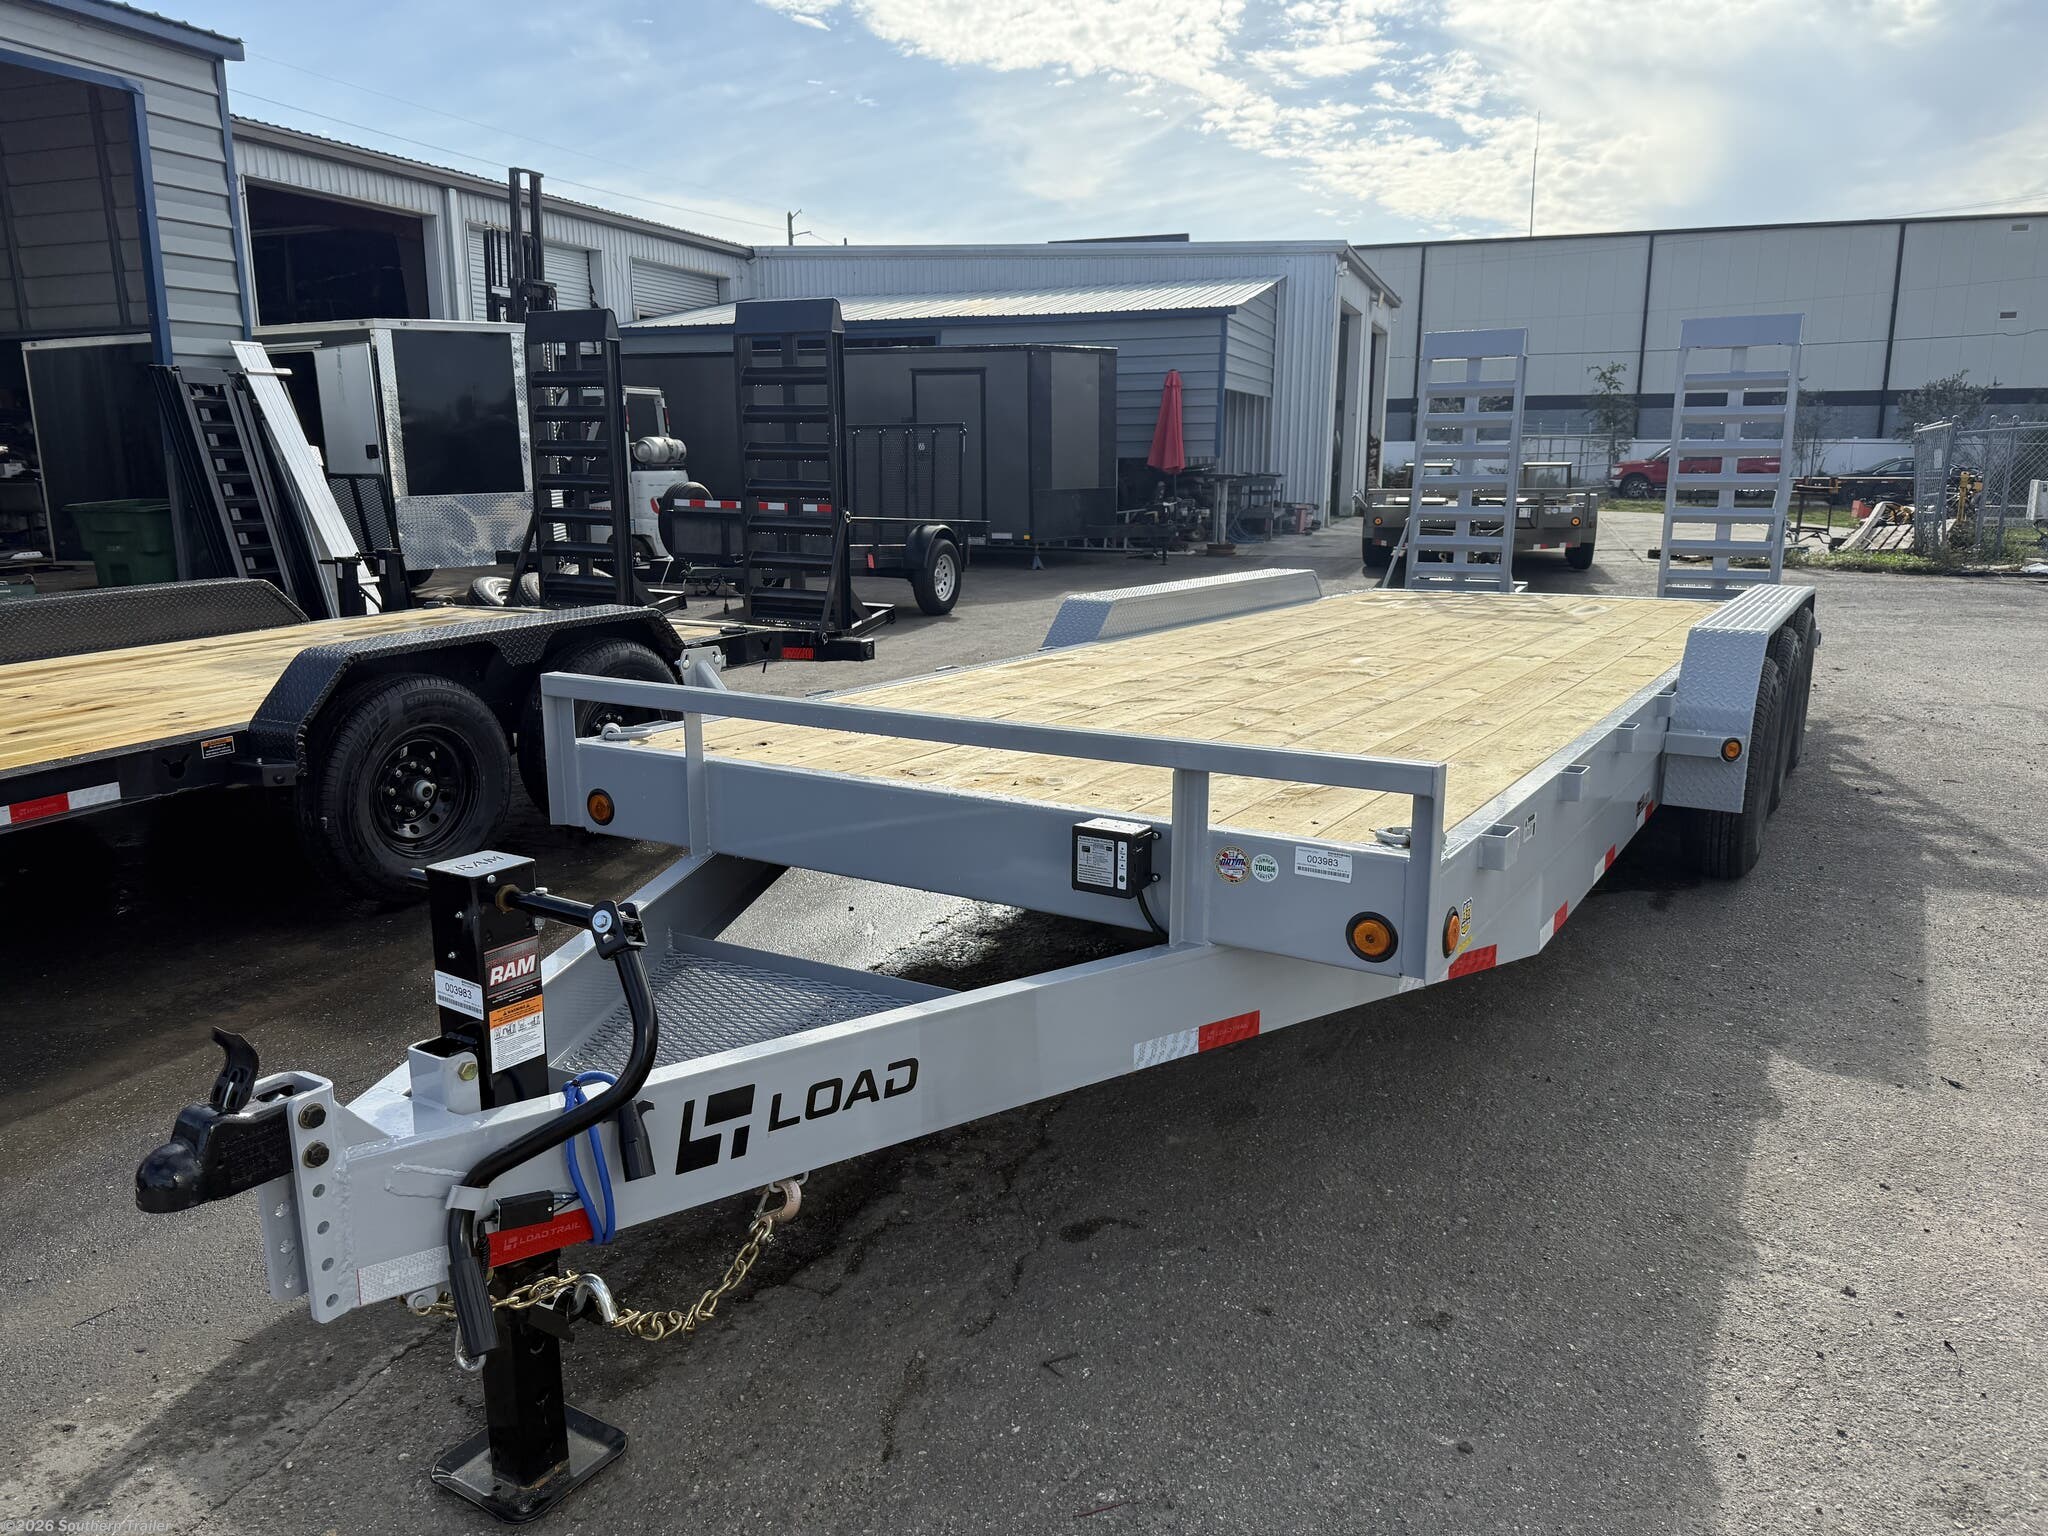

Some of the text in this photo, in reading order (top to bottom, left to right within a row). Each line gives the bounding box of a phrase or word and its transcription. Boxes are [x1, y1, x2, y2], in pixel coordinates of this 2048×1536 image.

[456, 855, 505, 871] RAM
[1255, 864, 1276, 872] TOUGH
[1306, 854, 1339, 867] 003983
[490, 954, 536, 986] RAM
[445, 982, 473, 999] 003983
[768, 1057, 919, 1132] LOAD
[520, 1231, 549, 1244] LOAD
[551, 1221, 581, 1236] TRAIL
